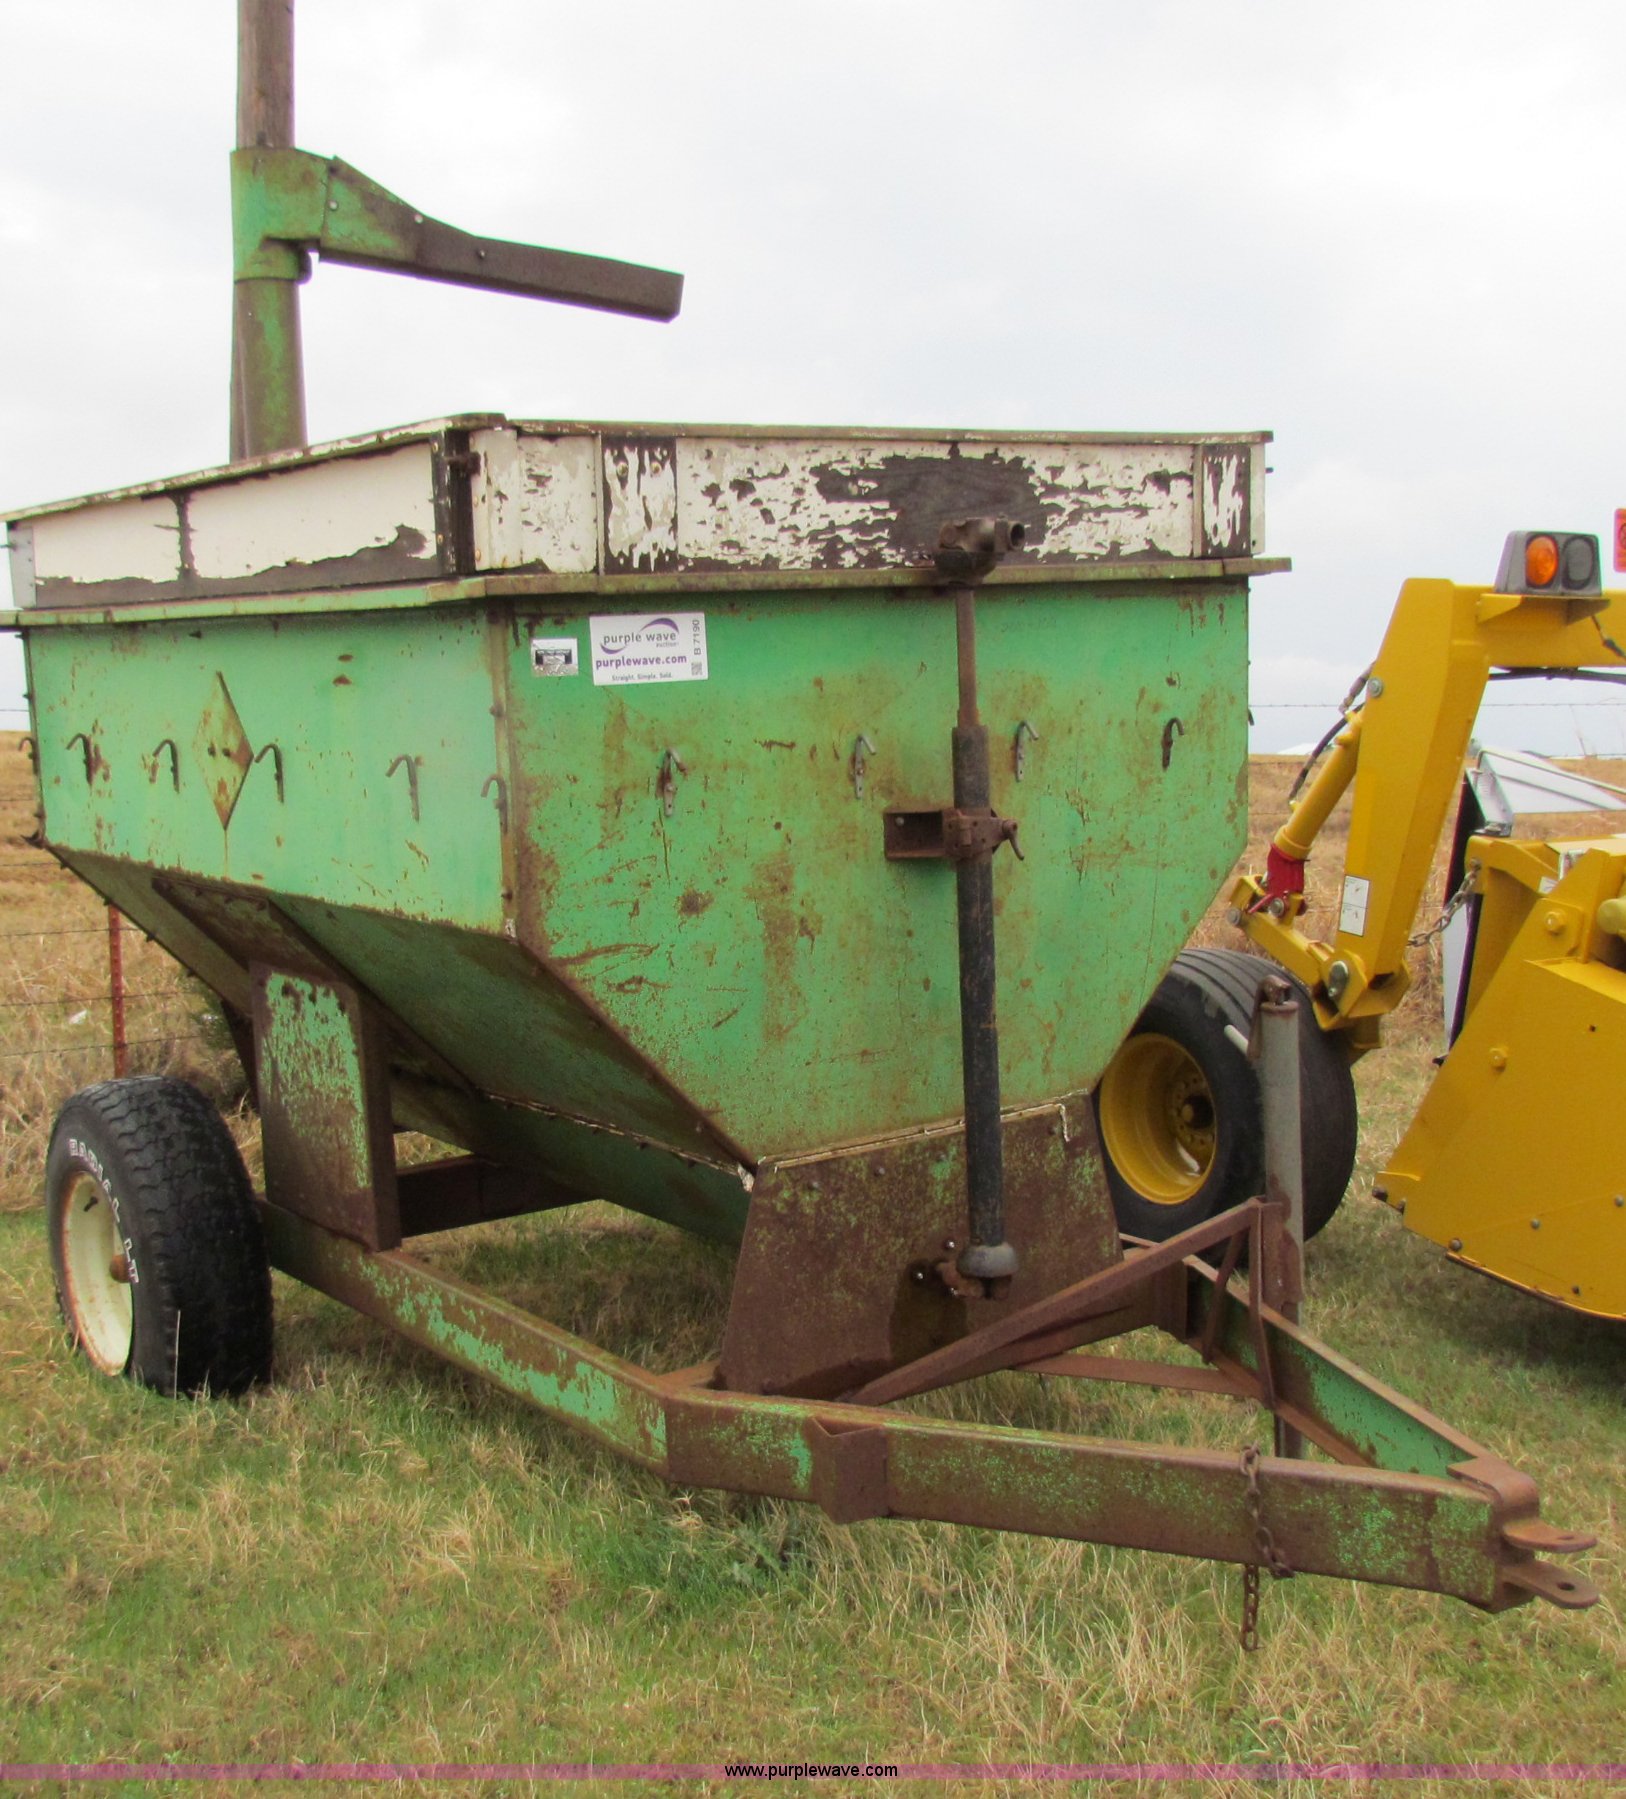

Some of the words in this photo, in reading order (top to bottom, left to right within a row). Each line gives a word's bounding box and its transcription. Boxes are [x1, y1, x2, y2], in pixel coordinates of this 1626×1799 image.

[603, 632, 641, 645] purple
[646, 632, 676, 641] wave
[692, 619, 701, 645] 7190
[596, 655, 687, 670] purplewave.com
[69, 1138, 120, 1223] RADIAL
[124, 1237, 139, 1283] LT
